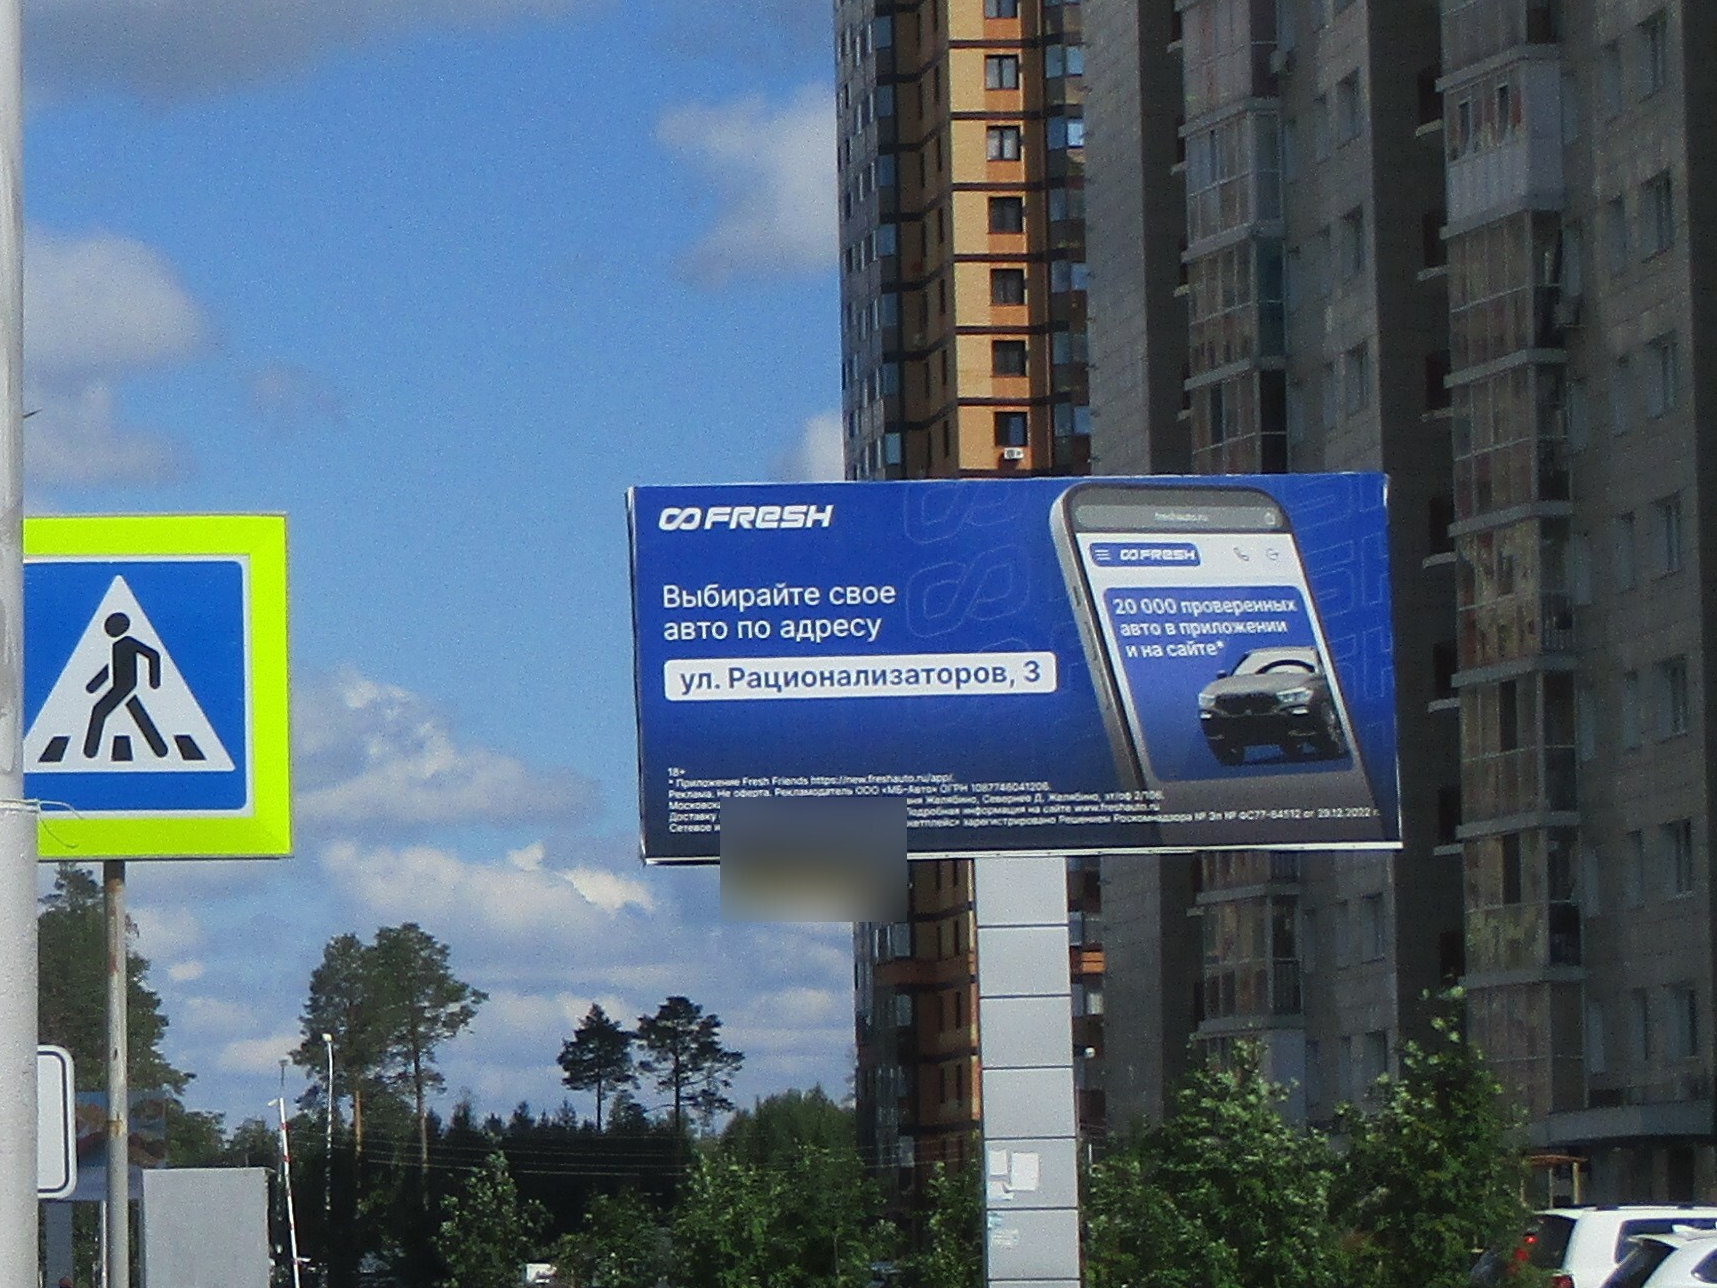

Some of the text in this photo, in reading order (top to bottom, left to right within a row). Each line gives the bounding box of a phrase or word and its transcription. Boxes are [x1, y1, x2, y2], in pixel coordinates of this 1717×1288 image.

[662, 582, 896, 612] Выбирайте свое
[1113, 598, 1297, 616] 20 000 проверенных
[663, 617, 882, 643] авто по адресу
[1120, 620, 1288, 638] авто в приложении
[1125, 645, 1138, 658] и
[1141, 644, 1163, 658] на
[680, 660, 1041, 695] ул. Рационализаторов, 3
[667, 767, 686, 777] 18+
[668, 790, 715, 800] Реклама.
[716, 789, 731, 798] Не
[774, 787, 853, 798] Рекламодатель
[855, 785, 879, 795] ООО
[939, 783, 968, 794] ОГРН
[676, 778, 740, 789] Приложение
[742, 776, 770, 786] Fresh
[772, 776, 809, 786] Friends
[669, 812, 716, 823] Доставку
[962, 806, 1025, 817] информация
[1028, 806, 1040, 815] на
[1043, 804, 1071, 813] сайте
[669, 824, 712, 833] Сетевое
